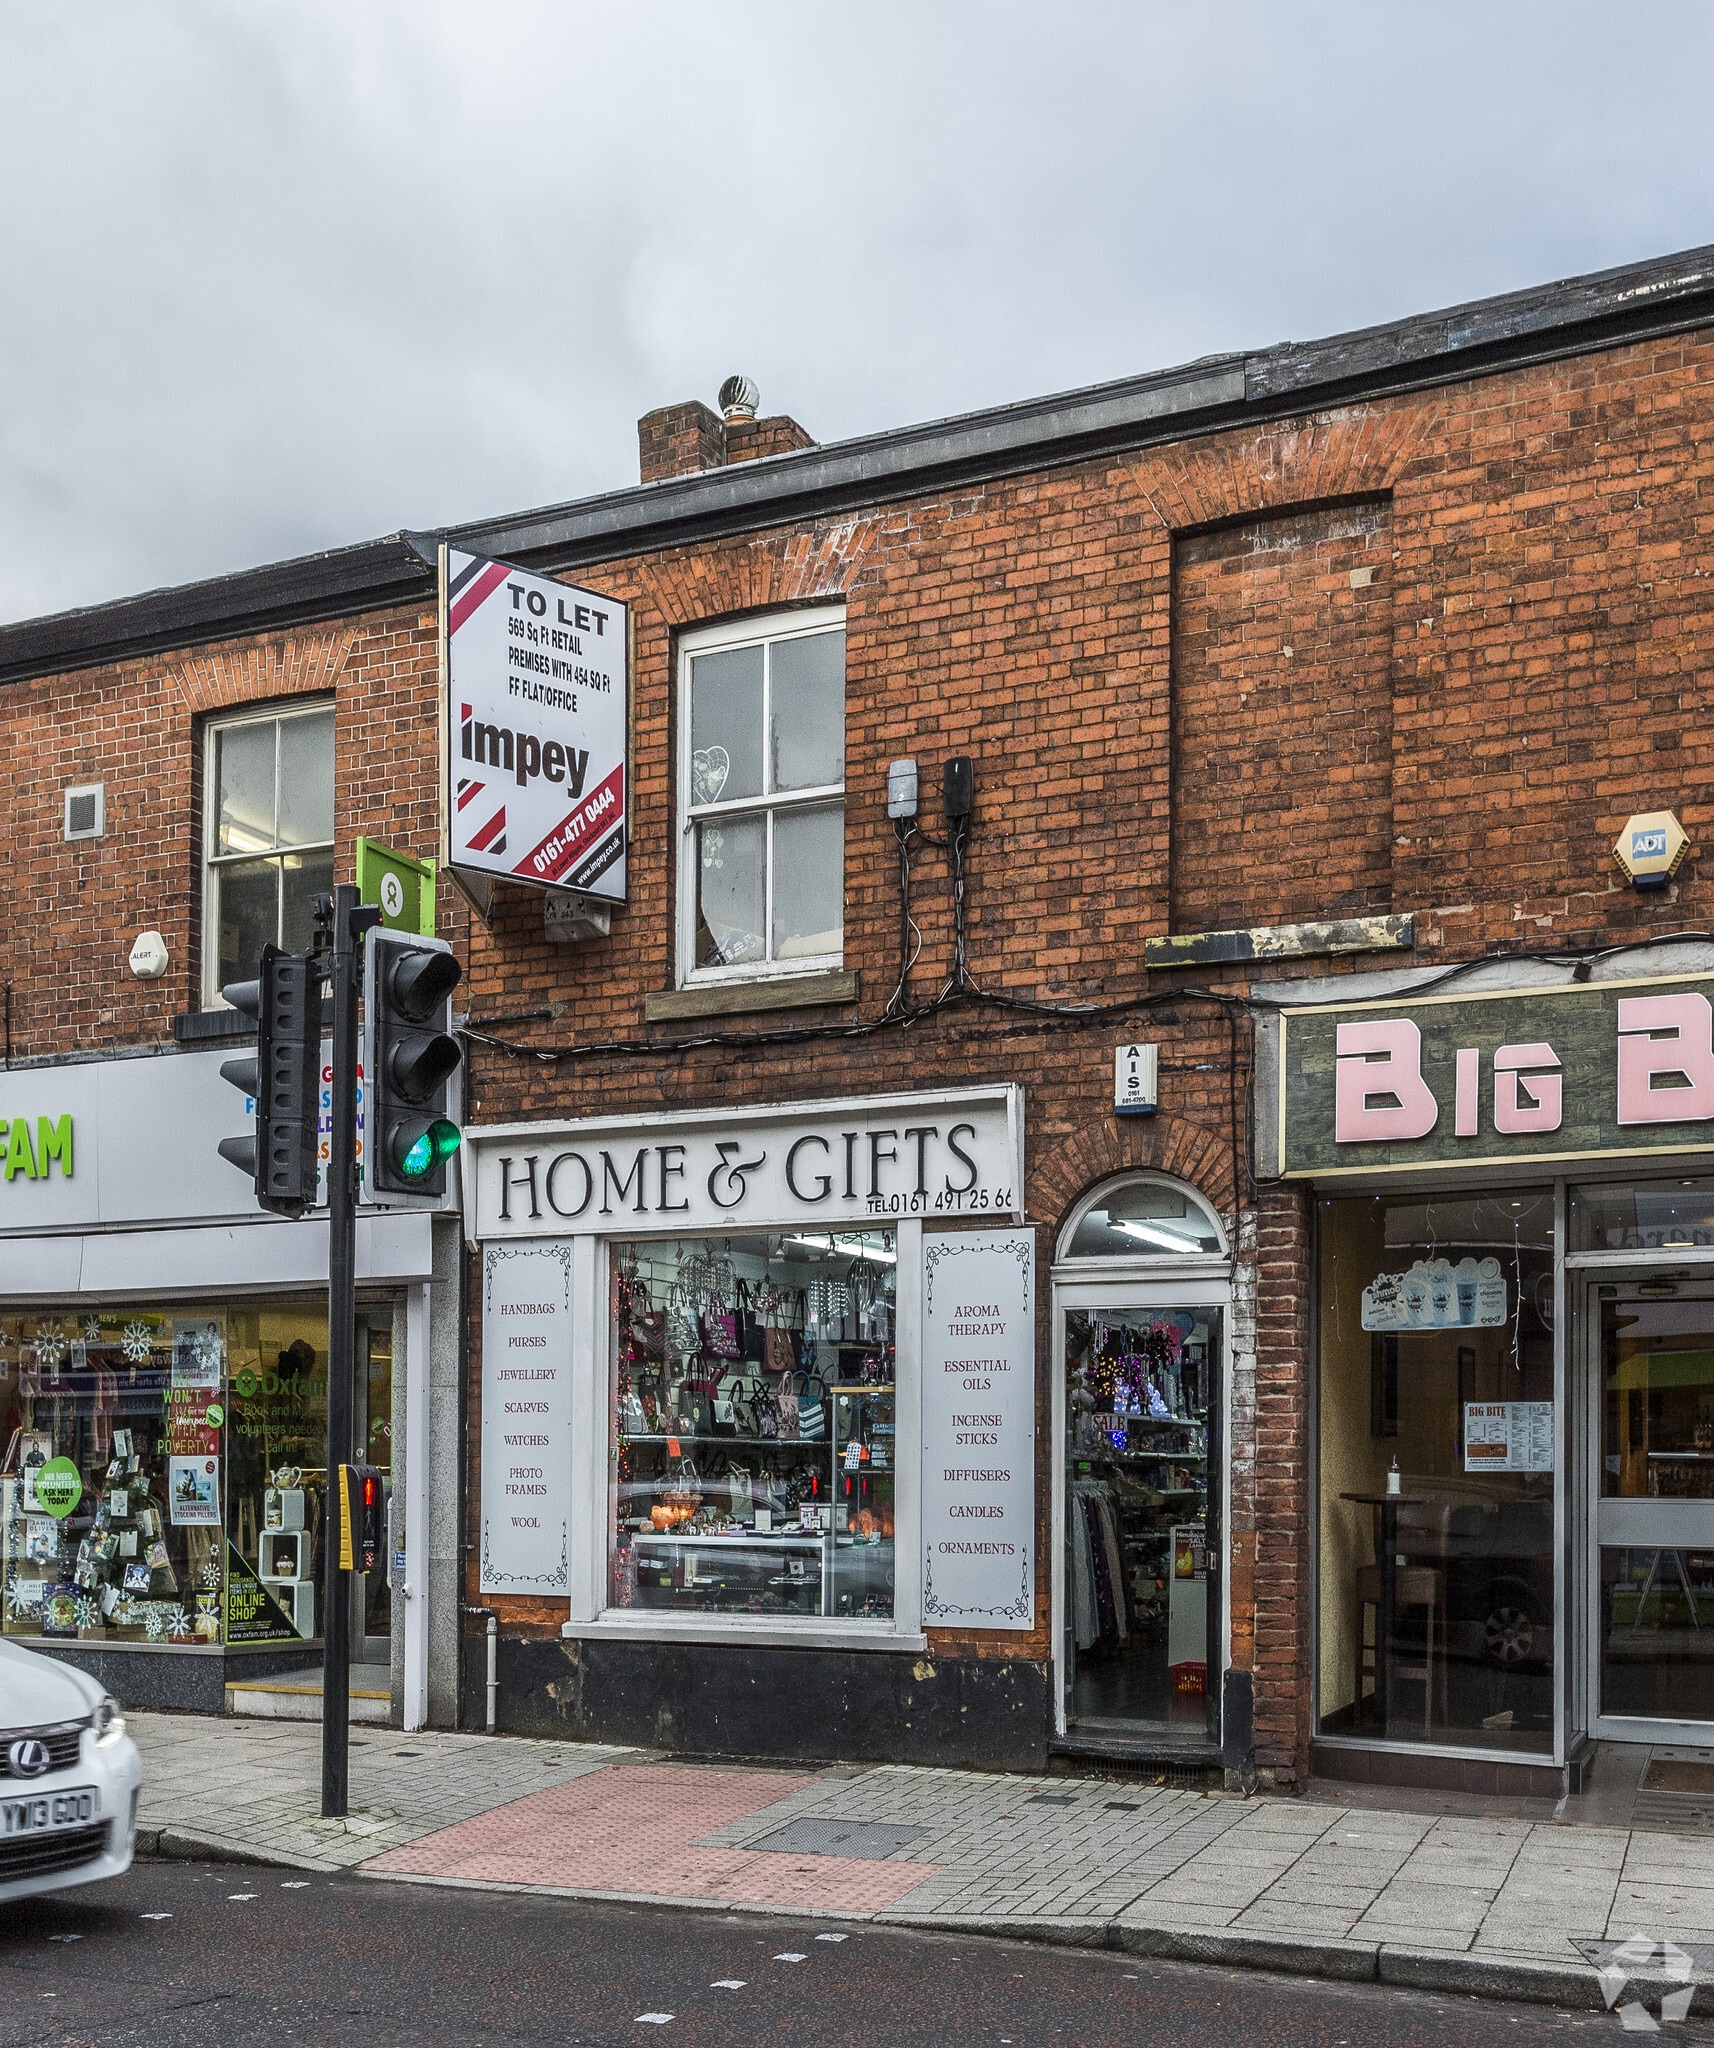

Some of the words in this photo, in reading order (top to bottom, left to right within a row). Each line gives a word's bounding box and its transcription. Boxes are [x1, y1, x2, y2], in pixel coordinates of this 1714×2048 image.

[507, 583, 547, 617] TO
[558, 598, 608, 636] LET
[508, 616, 525, 638] 569
[527, 621, 538, 647] Sq
[540, 625, 549, 646] Ft
[551, 629, 582, 656] RETAIL
[508, 646, 550, 676] PREMISES
[551, 658, 572, 682] WITH
[574, 666, 588, 687] 454
[590, 670, 601, 692] SQ
[602, 673, 611, 694] Ft
[509, 676, 520, 696] FF
[522, 679, 578, 713] FLAT/OFFICE
[461, 702, 590, 799] impey
[533, 812, 587, 873] 0161-477
[584, 786, 616, 823] 0444
[1633, 834, 1665, 853] ADT
[577, 837, 621, 885] www.impey.co.uk
[132, 951, 152, 959] ALERT
[1335, 1018, 1562, 1142] BIG
[0, 1114, 71, 1179] AM
[499, 1145, 689, 1220] HOME
[707, 1141, 766, 1208] &
[785, 1123, 978, 1204] GIFTS
[935, 1190, 962, 1211] 491
[969, 1189, 989, 1209] 25
[500, 1303, 555, 1316] HANDBAGS
[954, 1304, 1001, 1319] AROMA
[948, 1322, 1007, 1336] THERAPY
[508, 1336, 547, 1348] PURSES
[944, 1359, 1012, 1373] ESSENTIAL
[497, 1368, 556, 1382] JEWELLERY
[261, 1371, 328, 1396] Oxfam
[962, 1377, 992, 1391] OILS
[163, 1389, 201, 1404] WON'T
[244, 1403, 268, 1416] Book
[504, 1401, 550, 1414] SCARVES
[1469, 1406, 1484, 1417] BIG
[1486, 1406, 1506, 1417] BITE
[951, 1414, 1003, 1428] INCENSE
[1093, 1415, 1125, 1430] SALE
[165, 1423, 197, 1438] WITH
[236, 1422, 286, 1435] volunteers
[503, 1434, 550, 1447] WATCHES
[955, 1432, 999, 1446] STICKS
[157, 1439, 210, 1454] POVERTY
[45, 1472, 55, 1481] WE
[56, 1472, 73, 1480] NEED
[509, 1467, 543, 1480] PHOTO
[943, 1469, 1011, 1482] DIFFUSERS
[37, 1480, 80, 1489] VOLUNTEERS
[505, 1483, 547, 1496] FRAMES
[43, 1489, 56, 1497] ASK
[47, 1497, 70, 1505] TODAY
[949, 1505, 1005, 1519] CANDLES
[511, 1516, 541, 1529] WOOL
[938, 1542, 1015, 1556] ORNAMENTS
[229, 1593, 266, 1607] ONLINE
[229, 1607, 257, 1620] SHOP
[229, 1629, 291, 1639] www.oxfam.org.uk/shop
